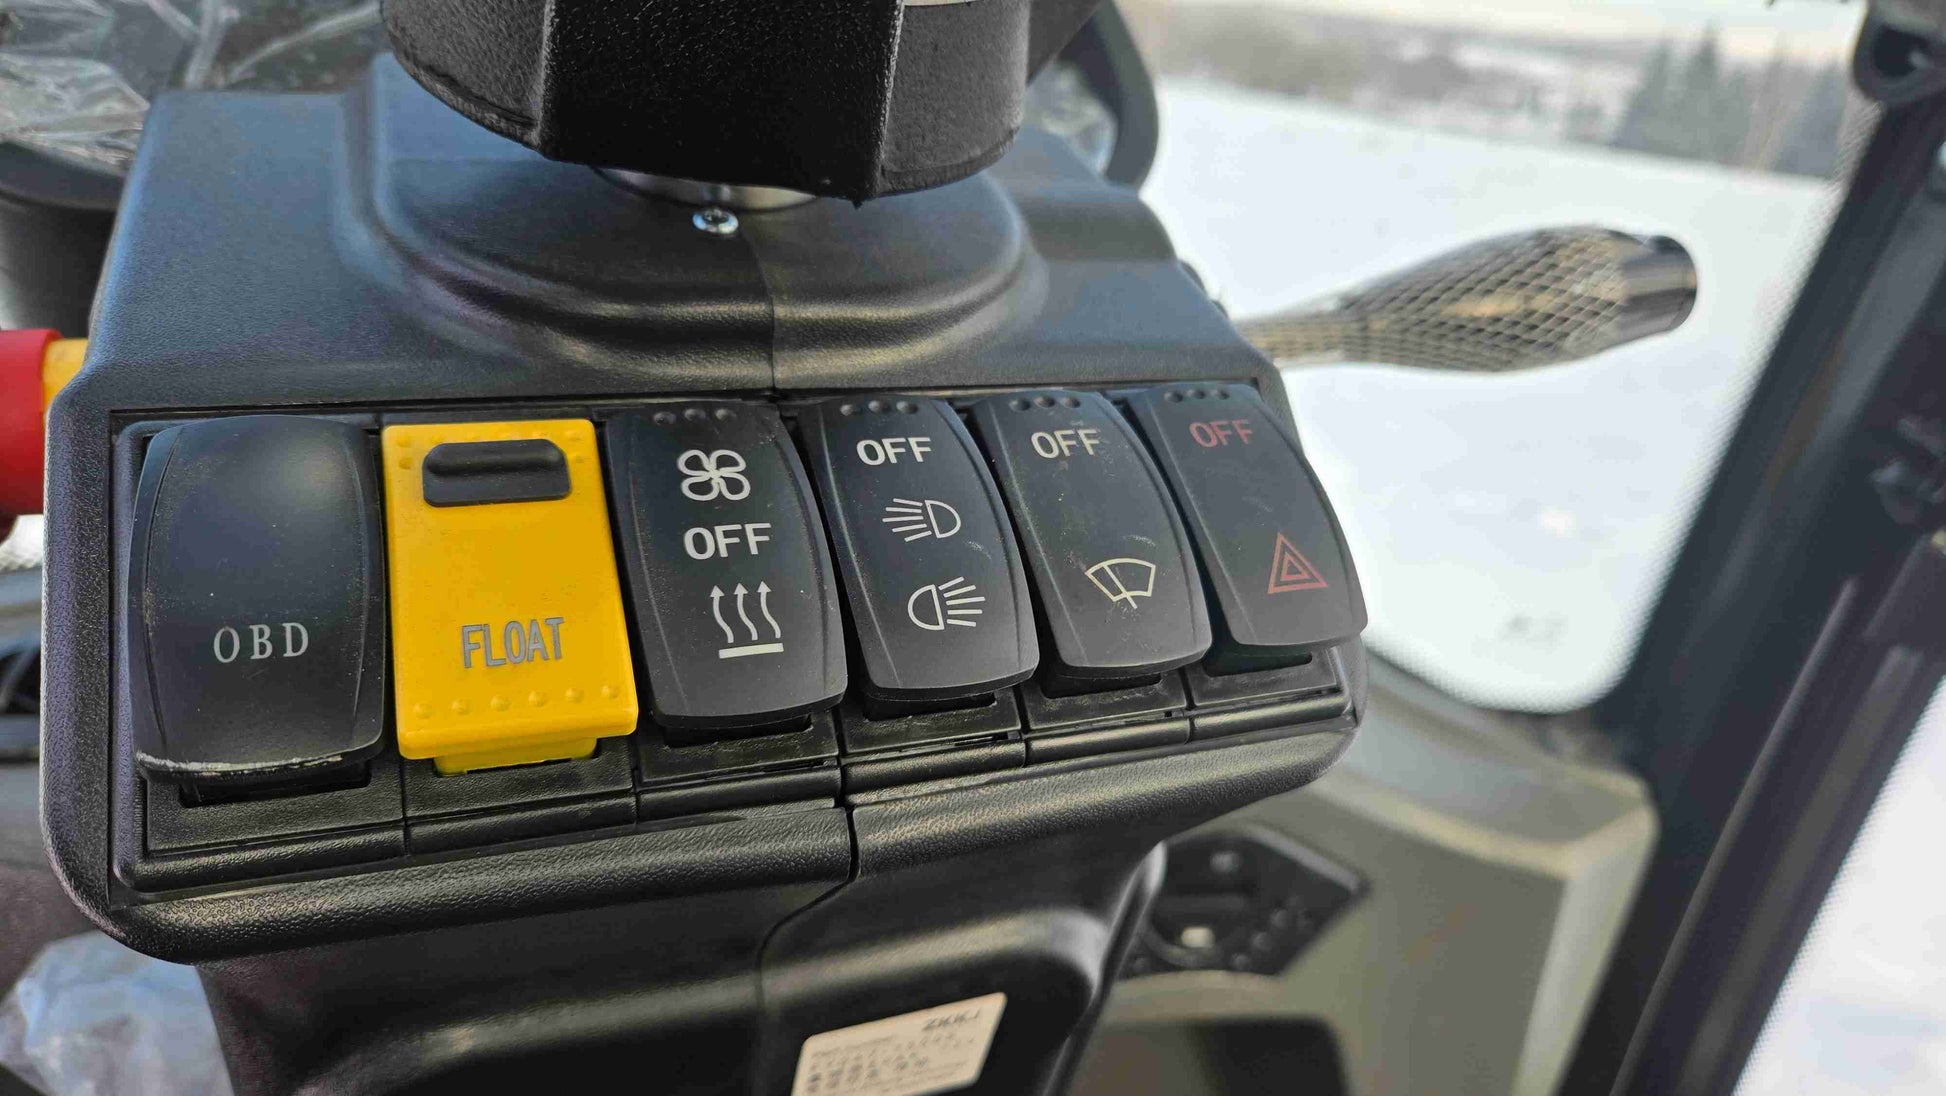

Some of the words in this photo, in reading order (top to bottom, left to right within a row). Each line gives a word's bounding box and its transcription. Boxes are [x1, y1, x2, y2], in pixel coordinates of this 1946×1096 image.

[856, 436, 932, 467] OFF
[1031, 427, 1101, 461] OFF
[1188, 419, 1254, 449] OFF
[683, 522, 773, 561] OFF
[213, 621, 310, 664] OBD
[462, 616, 565, 669] FLOAT
